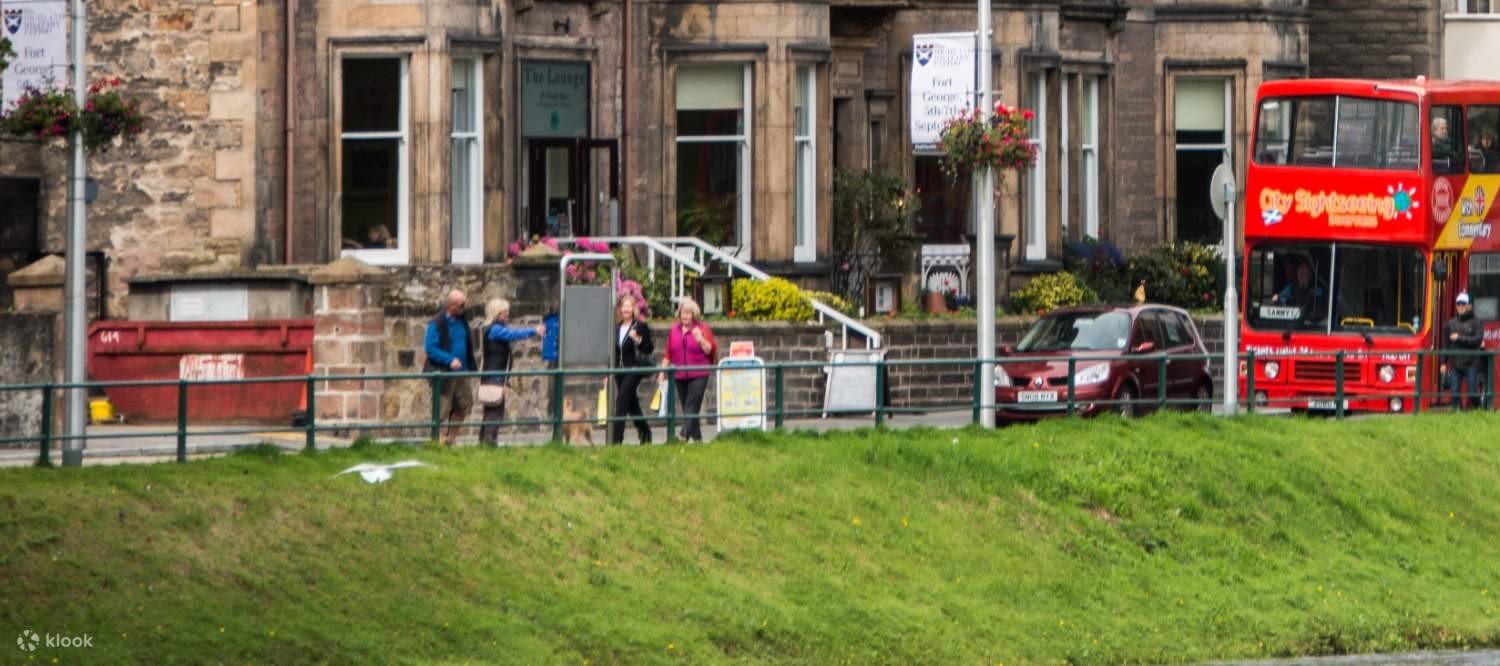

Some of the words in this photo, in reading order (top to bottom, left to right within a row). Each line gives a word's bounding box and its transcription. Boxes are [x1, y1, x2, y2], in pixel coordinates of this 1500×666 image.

[525, 67, 545, 84] The
[547, 67, 585, 90] Lounge
[932, 77, 953, 87] Fort
[1259, 187, 1293, 216] City
[1295, 187, 1396, 221] Sightseeing
